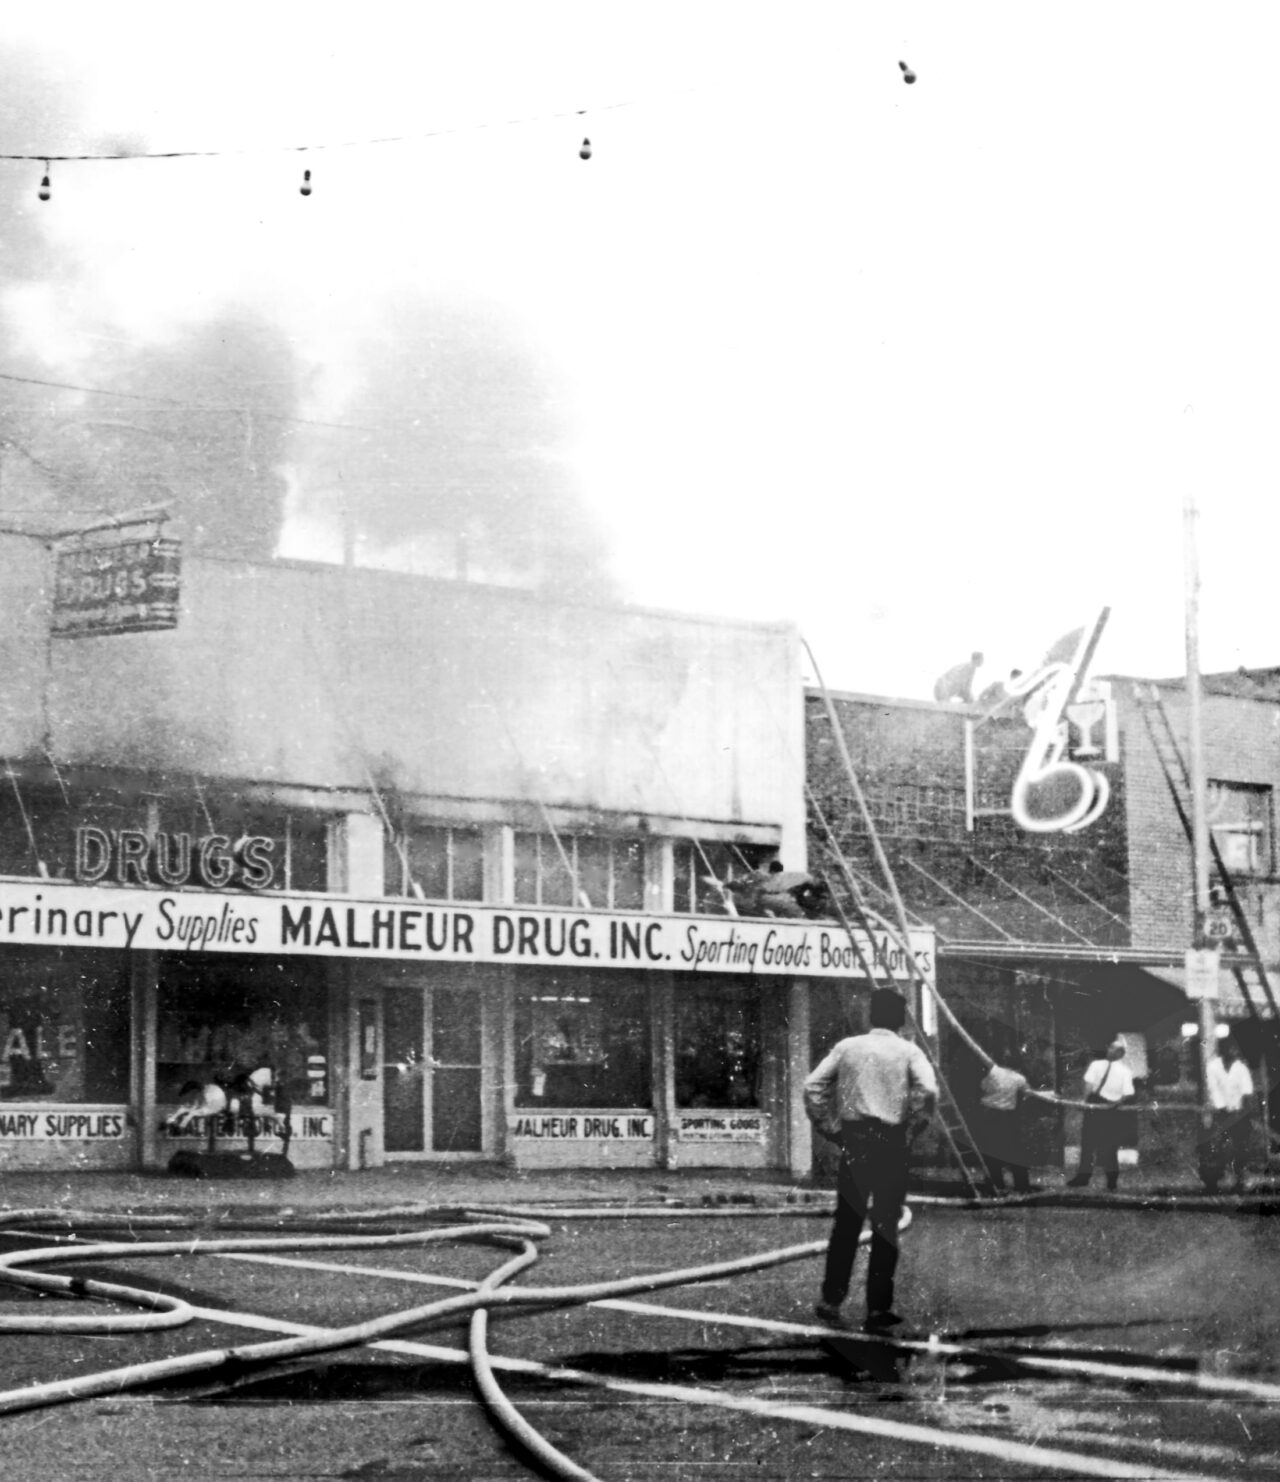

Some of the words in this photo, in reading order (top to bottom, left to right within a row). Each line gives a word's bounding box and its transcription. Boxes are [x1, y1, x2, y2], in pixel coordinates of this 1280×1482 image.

[75, 827, 274, 889] DRUGS
[157, 898, 259, 950] Supplies
[281, 905, 474, 954] MALHEUR
[610, 920, 671, 961] INC.
[681, 925, 758, 972] Sporting
[763, 930, 813, 968] Goods
[45, 1115, 122, 1137] SUPPLIES
[730, 1118, 760, 1130] GOODS
